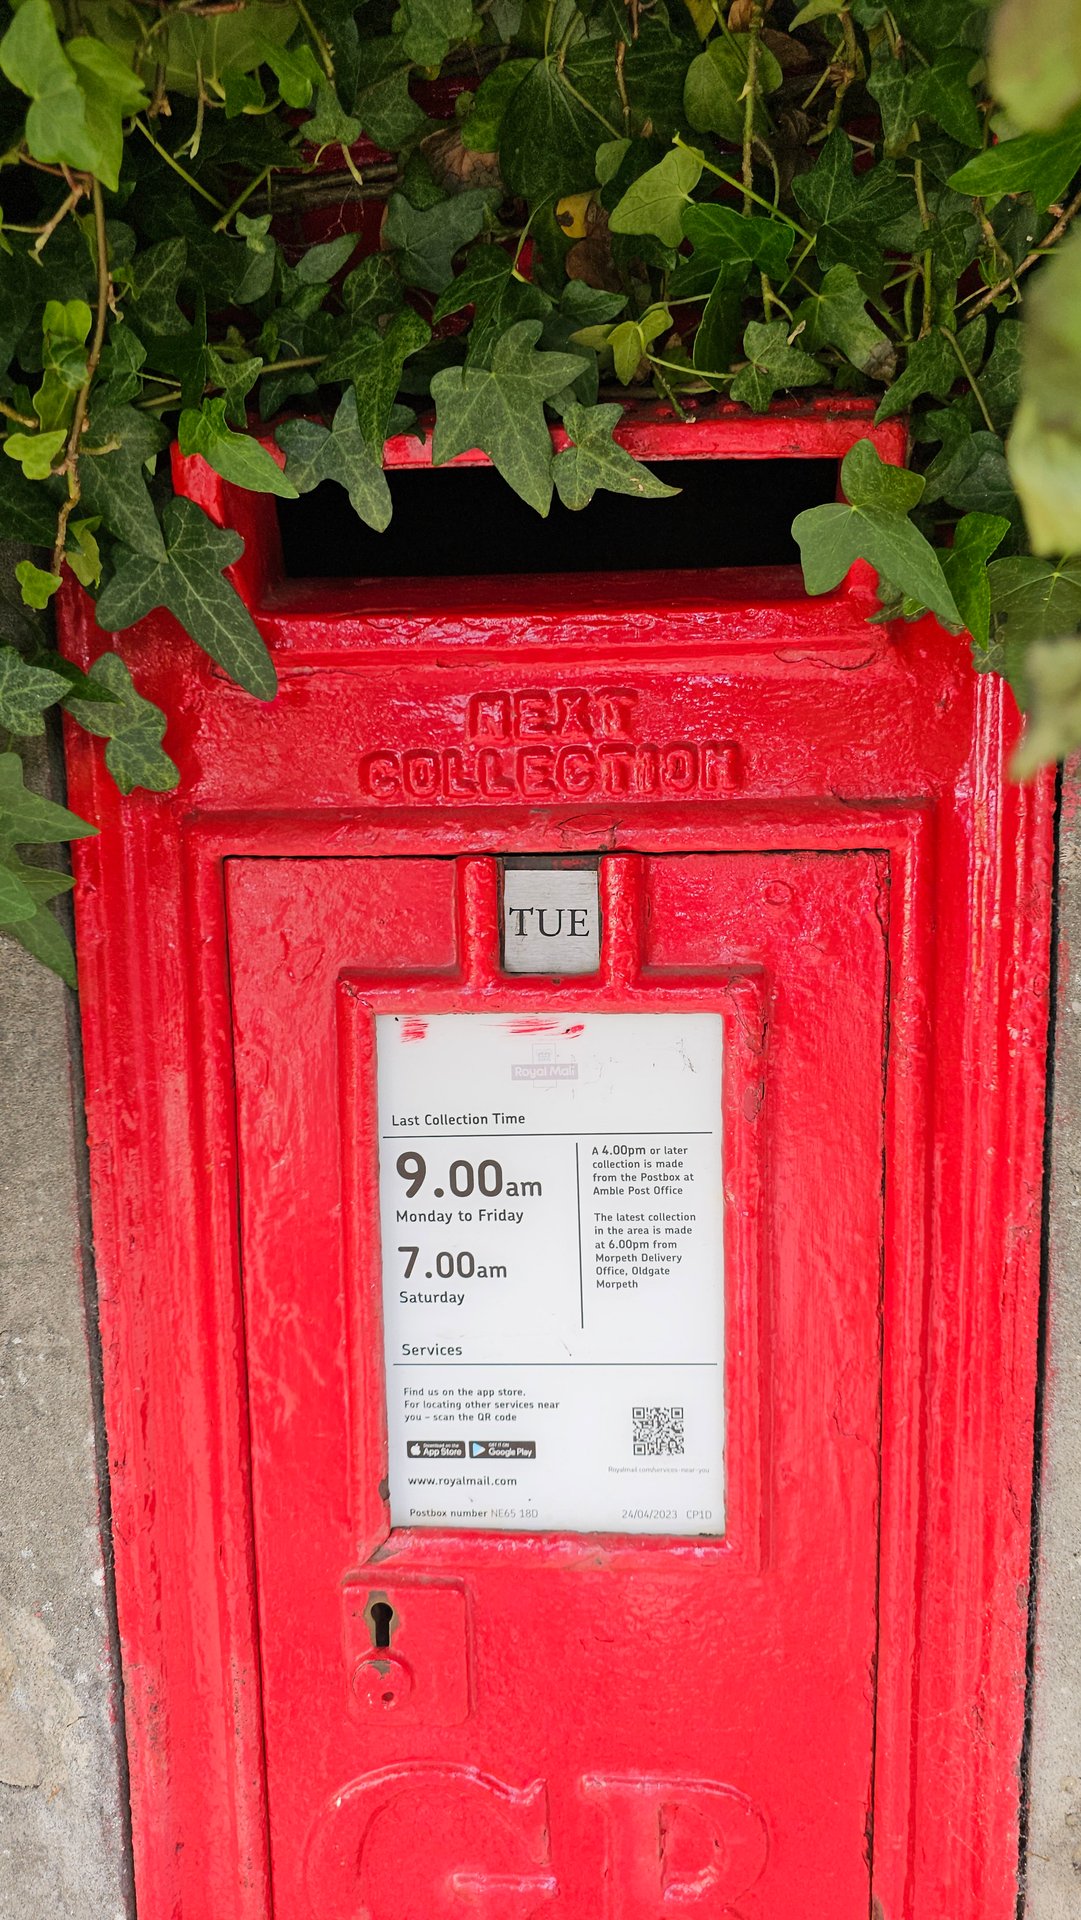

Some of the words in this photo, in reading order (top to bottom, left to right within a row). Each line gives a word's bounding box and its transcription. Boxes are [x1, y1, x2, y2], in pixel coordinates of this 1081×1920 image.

[468, 689, 640, 741] NEXT
[358, 740, 744, 799] COLLECTION
[509, 906, 590, 938] TUE
[514, 1066, 547, 1078] Royal
[392, 1115, 420, 1126] Last
[425, 1113, 488, 1125] Collection
[492, 1113, 525, 1124] Time
[592, 1147, 598, 1155] A
[602, 1145, 646, 1157] 4.00pm
[664, 1146, 688, 1154] later
[593, 1160, 640, 1168] collection
[644, 1159, 652, 1168] is
[656, 1159, 683, 1168] made
[396, 1152, 542, 1198] 9.00am
[593, 1173, 616, 1182] from
[621, 1173, 636, 1181] the
[641, 1173, 680, 1181] Postbox
[684, 1173, 694, 1181] at
[593, 1187, 624, 1195] Amble
[629, 1186, 650, 1195] Post
[654, 1186, 683, 1194] Office
[397, 1210, 452, 1224] Monday
[458, 1211, 472, 1221] to
[479, 1209, 523, 1224] Friday
[594, 1213, 612, 1221] The
[617, 1213, 644, 1221] latest
[648, 1212, 695, 1221] collection
[595, 1226, 603, 1234] in
[608, 1226, 623, 1234] the
[653, 1226, 661, 1234] is
[665, 1226, 692, 1234] made
[595, 1241, 605, 1249] at
[609, 1240, 649, 1251] 6.00pm
[653, 1240, 677, 1248] from
[398, 1246, 507, 1278] 7.00am
[596, 1254, 637, 1264] Morpeth
[642, 1253, 682, 1263] Delivery
[596, 1266, 627, 1276] Office,
[632, 1267, 670, 1277] Oldgate
[597, 1280, 638, 1290] Morpeth
[400, 1291, 464, 1305] Saturday
[402, 1344, 462, 1355] Services
[458, 1388, 473, 1396] the
[405, 1400, 419, 1408] For
[424, 1400, 461, 1410] locating
[495, 1400, 534, 1408] services
[459, 1413, 473, 1421] the
[478, 1413, 491, 1421] QR
[495, 1413, 516, 1421] code
[423, 1448, 439, 1457] App
[440, 1448, 462, 1456] Store
[488, 1448, 516, 1457] Google
[517, 1448, 533, 1457] Play
[408, 1476, 517, 1487] www.royalmail.com
[491, 1509, 516, 1517] NE65
[520, 1509, 538, 1518] 18D
[622, 1509, 677, 1519] 24/04/2023
[687, 1510, 711, 1519] CP1D
